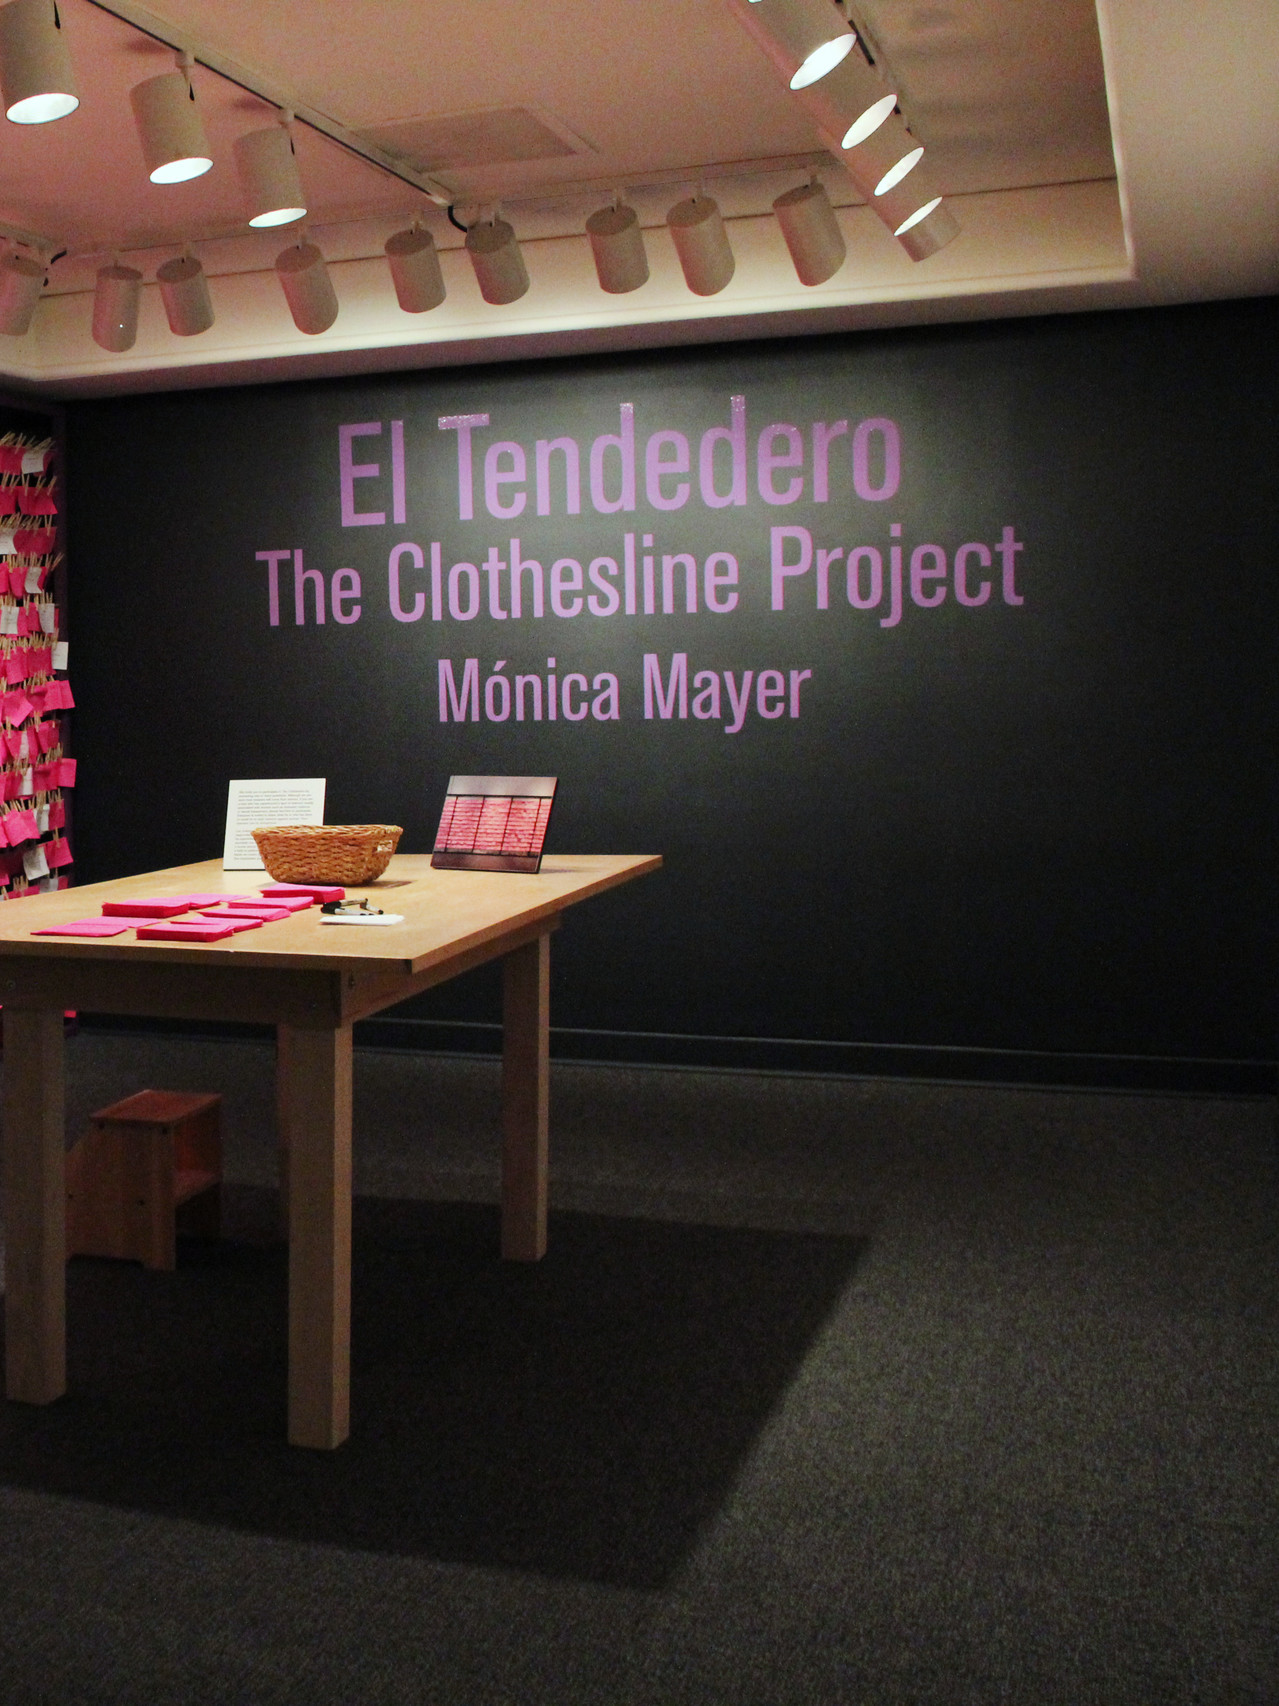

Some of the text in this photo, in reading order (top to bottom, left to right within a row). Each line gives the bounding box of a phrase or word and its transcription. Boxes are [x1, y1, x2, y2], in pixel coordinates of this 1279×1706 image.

[339, 394, 901, 527] El Tendedero
[255, 523, 1024, 628] The Clothesline Project
[437, 652, 811, 733] Mónica Mayer
